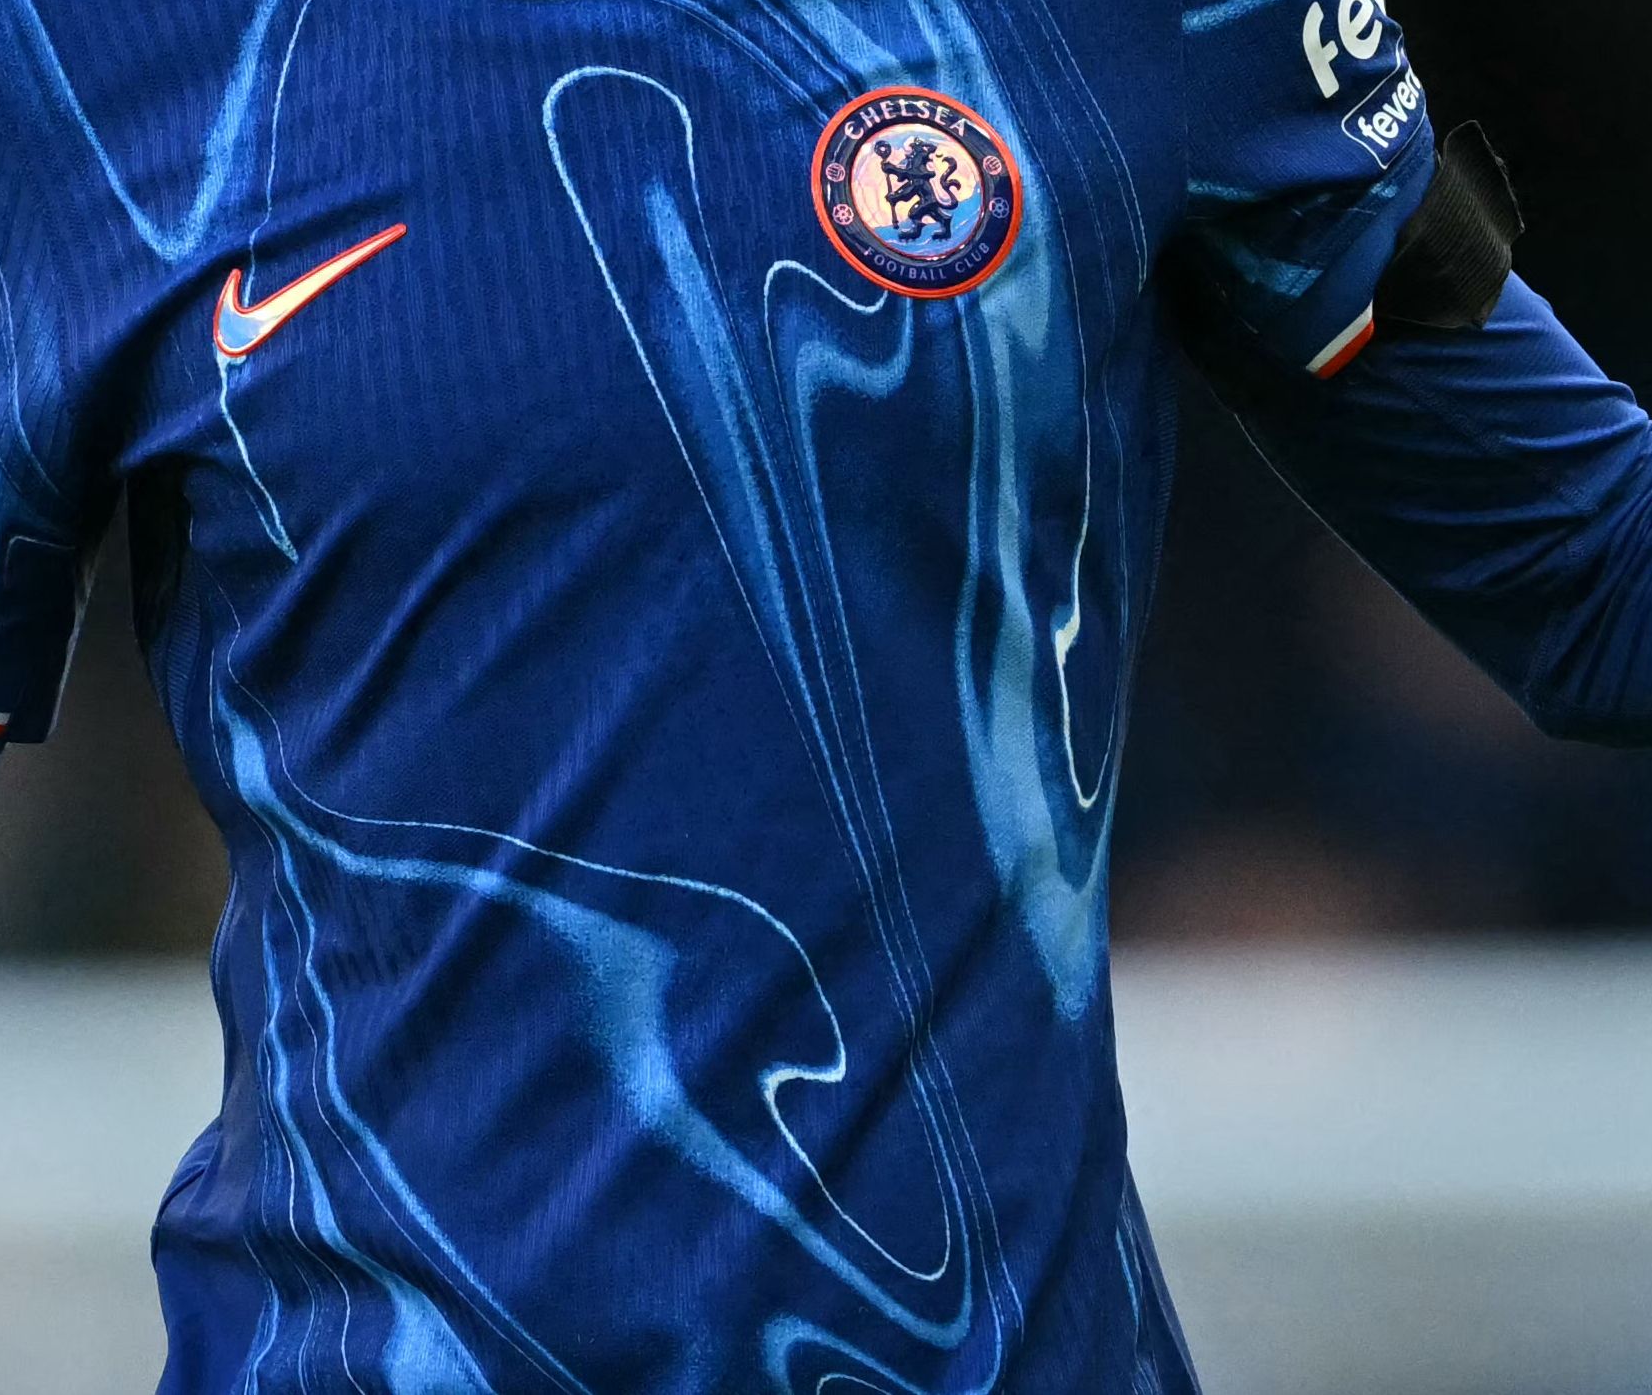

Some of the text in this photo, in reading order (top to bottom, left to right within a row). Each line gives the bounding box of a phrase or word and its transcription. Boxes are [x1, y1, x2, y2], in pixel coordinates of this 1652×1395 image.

[844, 98, 968, 140] CHELSEA
[863, 241, 990, 281] FOOTBALL CLUB
